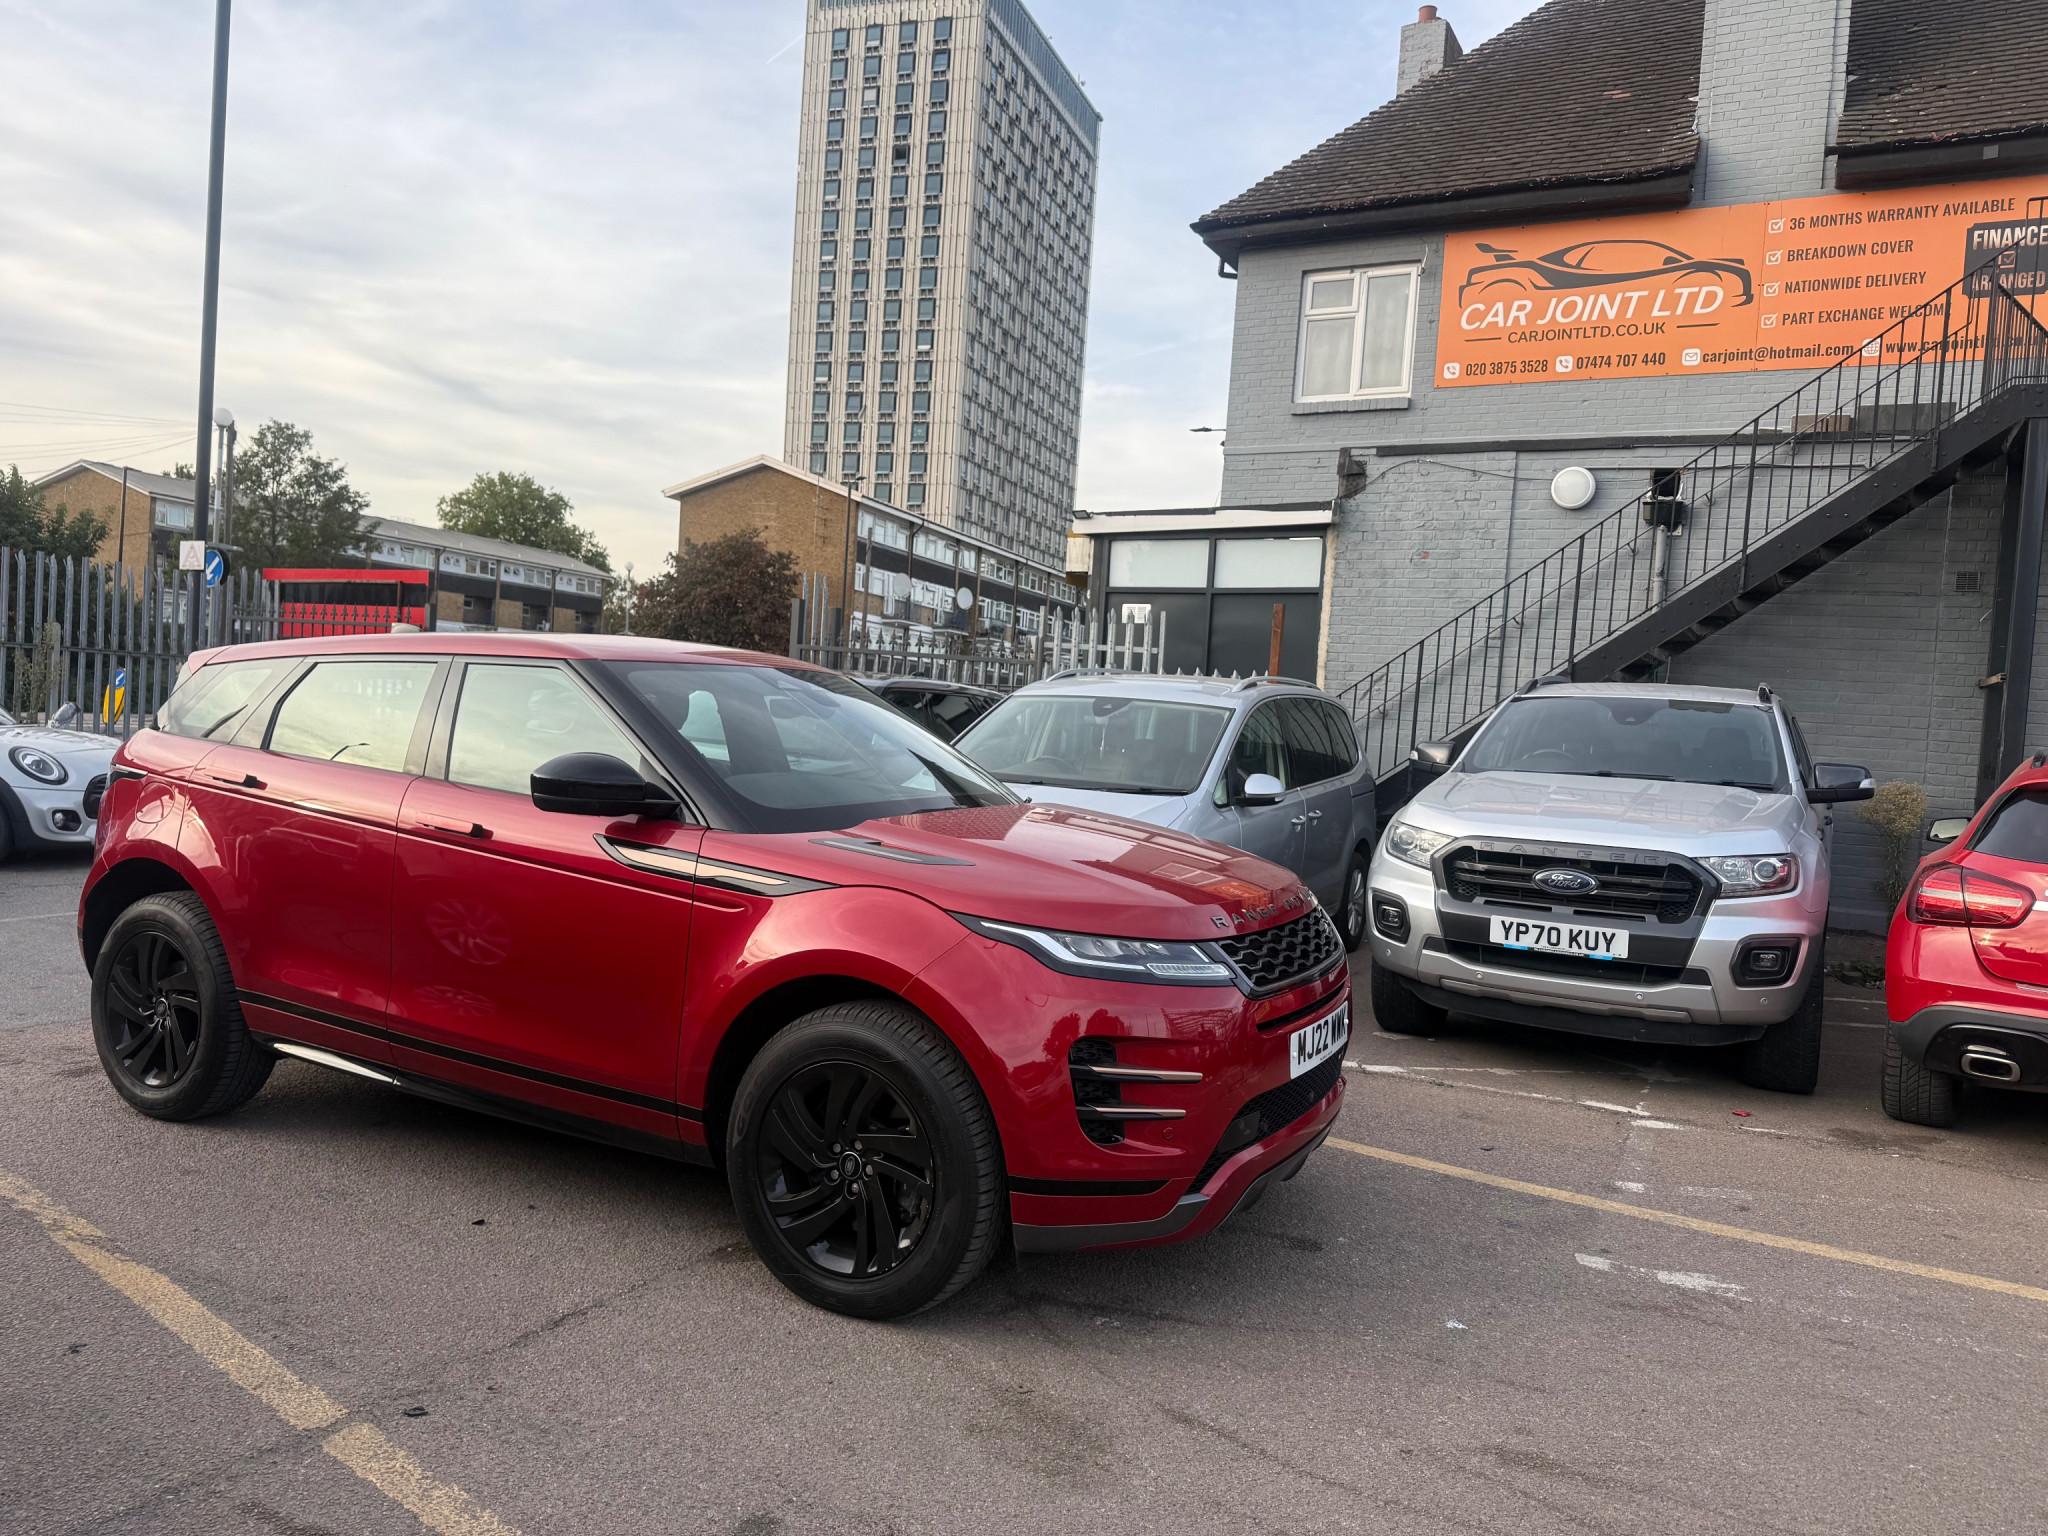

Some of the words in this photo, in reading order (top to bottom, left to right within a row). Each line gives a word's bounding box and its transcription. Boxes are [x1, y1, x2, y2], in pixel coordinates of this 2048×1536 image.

[1789, 217, 1805, 231] 36
[1809, 211, 1862, 229] MONTHS
[1867, 205, 1938, 223] WARRANTY
[1943, 197, 2016, 217] AVAILABLE
[1973, 225, 2048, 250] FINANCE
[1787, 243, 1867, 262] BREAKDOWN
[1871, 239, 1914, 255] COVER
[1784, 275, 1861, 294] NATIONWIDE
[1865, 271, 1926, 288] DELIVERY
[1459, 299, 1533, 330] CAR
[1537, 290, 1649, 325] JOINT
[1650, 285, 1724, 317] LTD
[1782, 311, 1815, 326] PART
[1818, 306, 1884, 324] EXCHANGE
[1889, 302, 1951, 319] WELCOM
[1507, 322, 1666, 344] CARJOINTLTD.CO.UK
[1576, 355, 1612, 370] 07474
[1615, 353, 1638, 367] 707
[1642, 352, 1666, 366] 440
[1702, 343, 1855, 364] carjoint@hotmail.com
[1465, 363, 1487, 376] 020
[1489, 361, 1517, 375] 3875
[1519, 359, 1548, 374] 3528
[1548, 873, 1581, 888] Ford
[1500, 920, 1561, 947] YP70
[1568, 928, 1616, 953] KUY
[1297, 1019, 1329, 1066] MJ22
